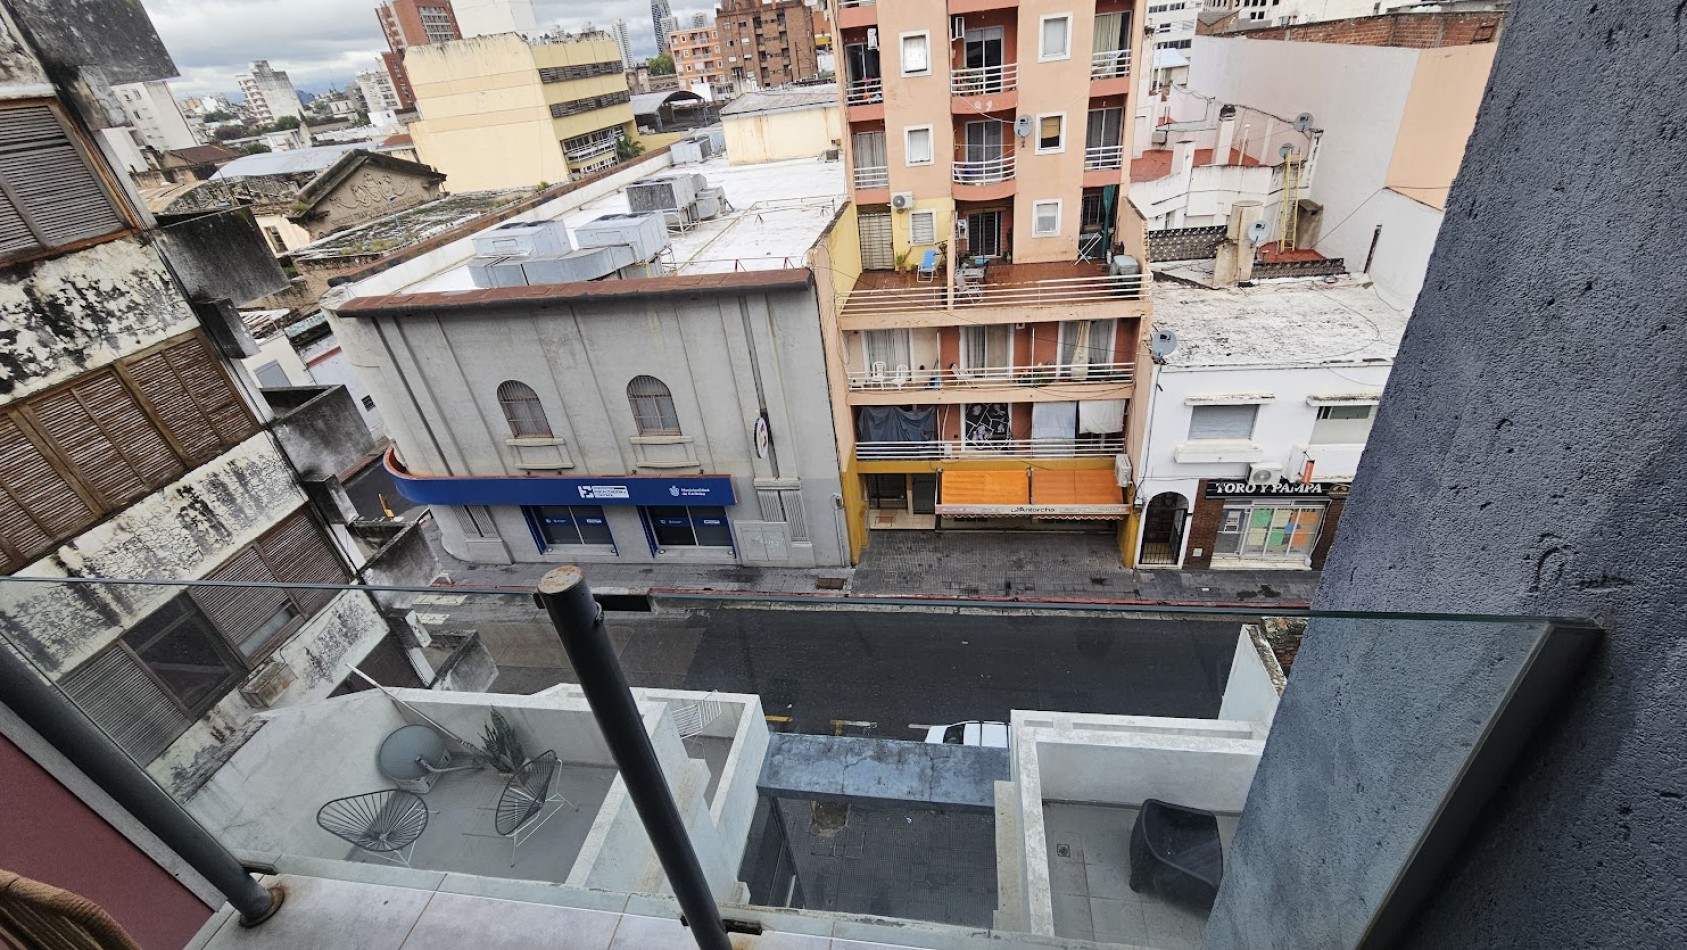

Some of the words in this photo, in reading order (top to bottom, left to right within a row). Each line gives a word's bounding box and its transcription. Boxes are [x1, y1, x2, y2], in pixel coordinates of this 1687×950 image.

[1215, 483, 1256, 493] TORO
[1260, 484, 1268, 493] Y
[1271, 483, 1322, 493] PAMPA
